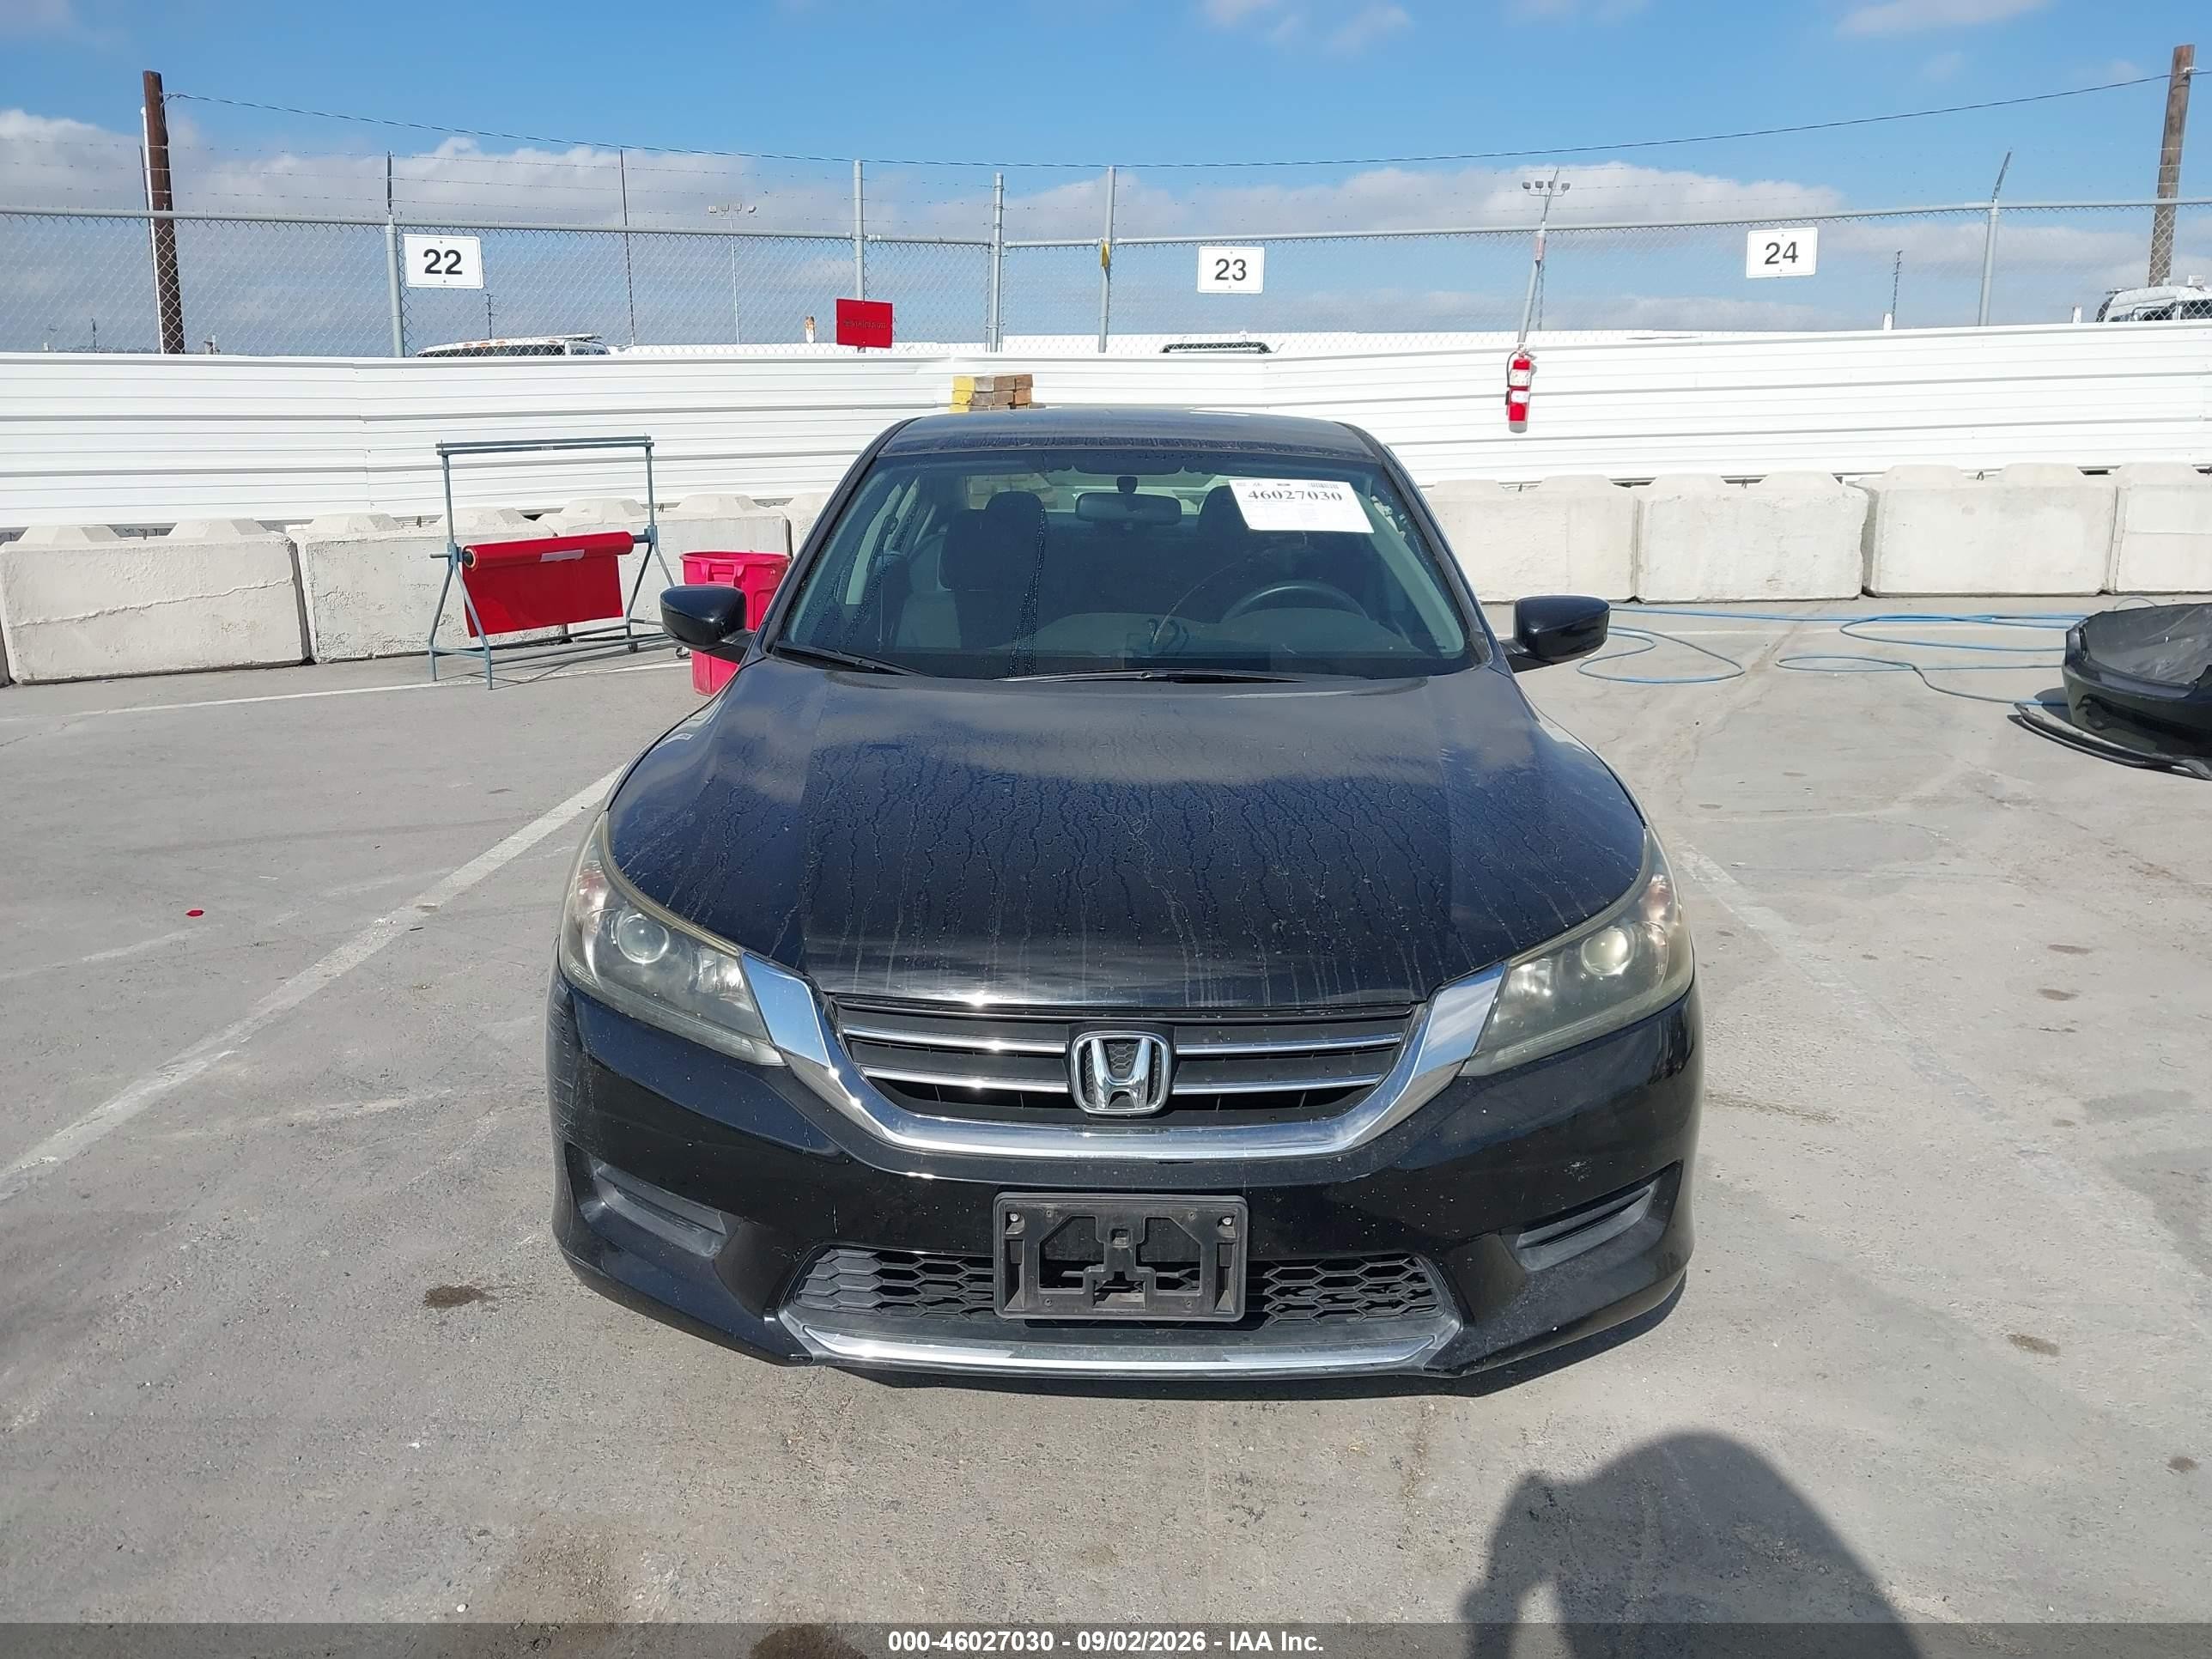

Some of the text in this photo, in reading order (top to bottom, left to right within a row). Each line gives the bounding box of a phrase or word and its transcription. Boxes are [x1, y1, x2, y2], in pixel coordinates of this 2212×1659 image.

[423, 248, 463, 275] 22
[1764, 241, 1799, 265] 24
[1214, 258, 1247, 282] 23
[1248, 489, 1343, 501] 46027030
